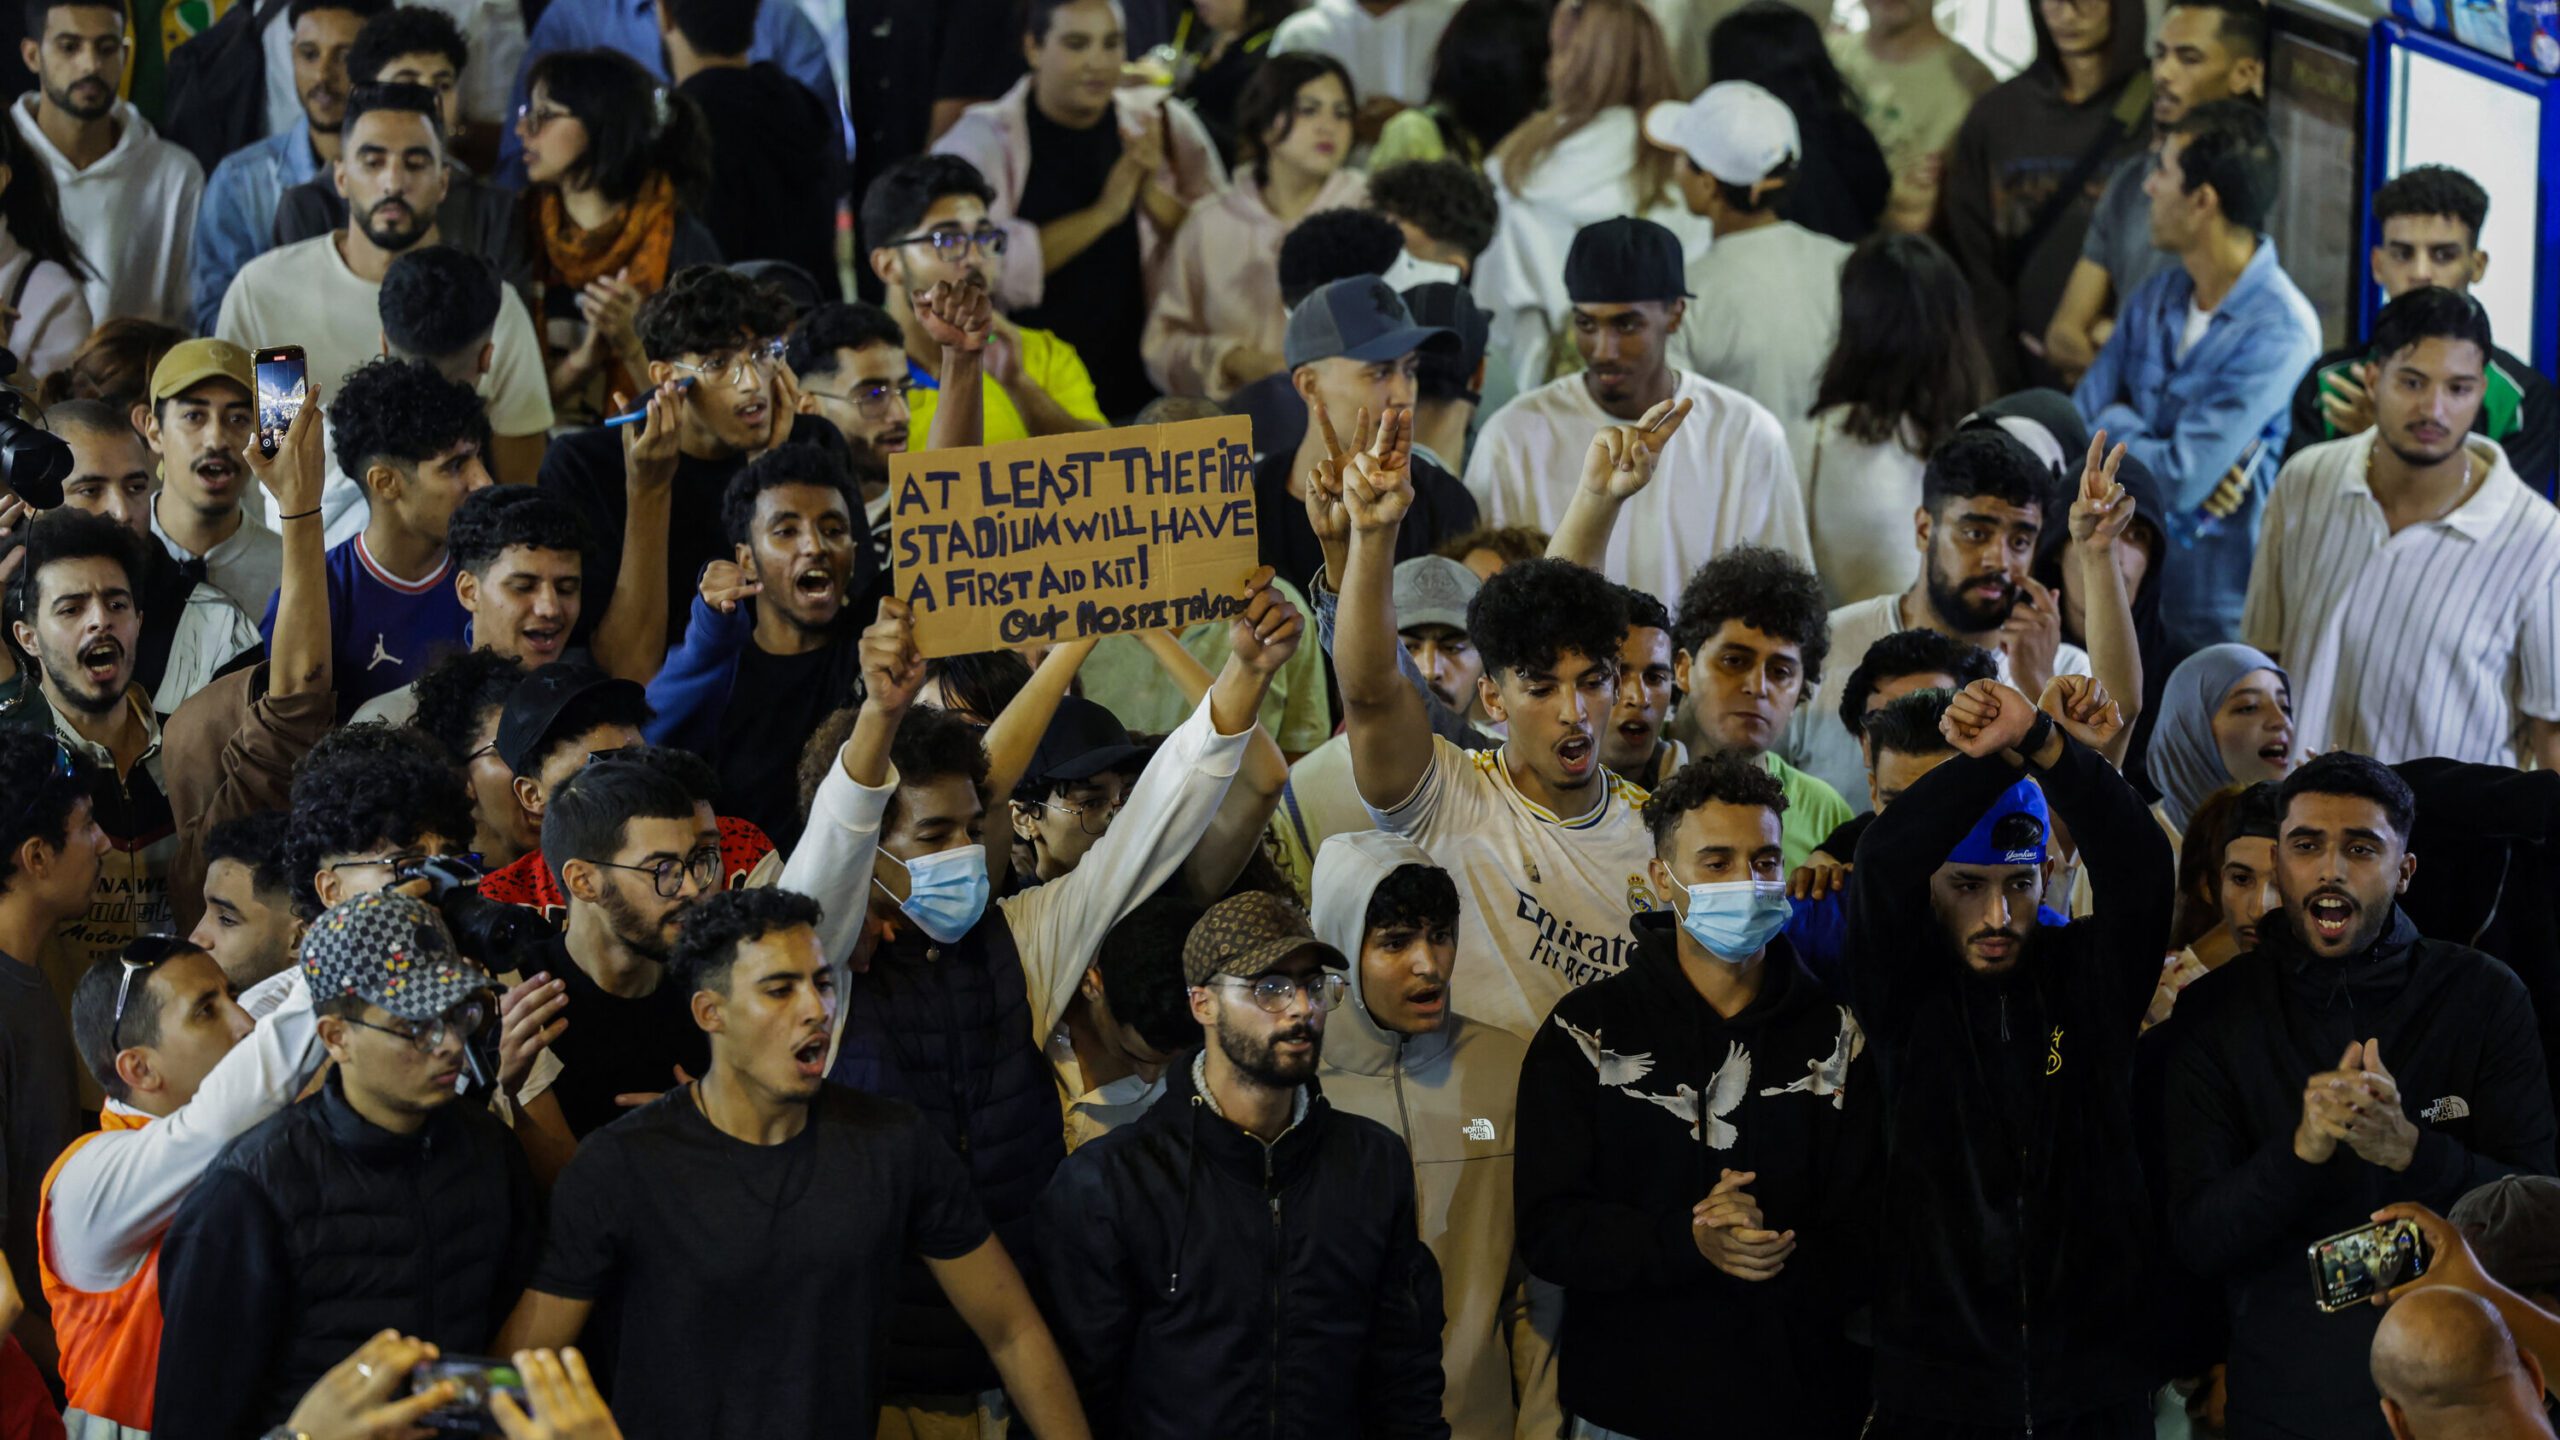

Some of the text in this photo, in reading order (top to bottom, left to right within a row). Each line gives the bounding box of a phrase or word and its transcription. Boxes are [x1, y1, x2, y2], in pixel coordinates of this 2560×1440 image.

[896, 471, 960, 516] AT
[978, 452, 1105, 508] LEAST
[1109, 446, 1194, 495] THE
[1063, 503, 1147, 543] WILL
[1150, 499, 1255, 545] HAVE
[908, 572, 937, 613] A
[1038, 562, 1087, 600] AID
